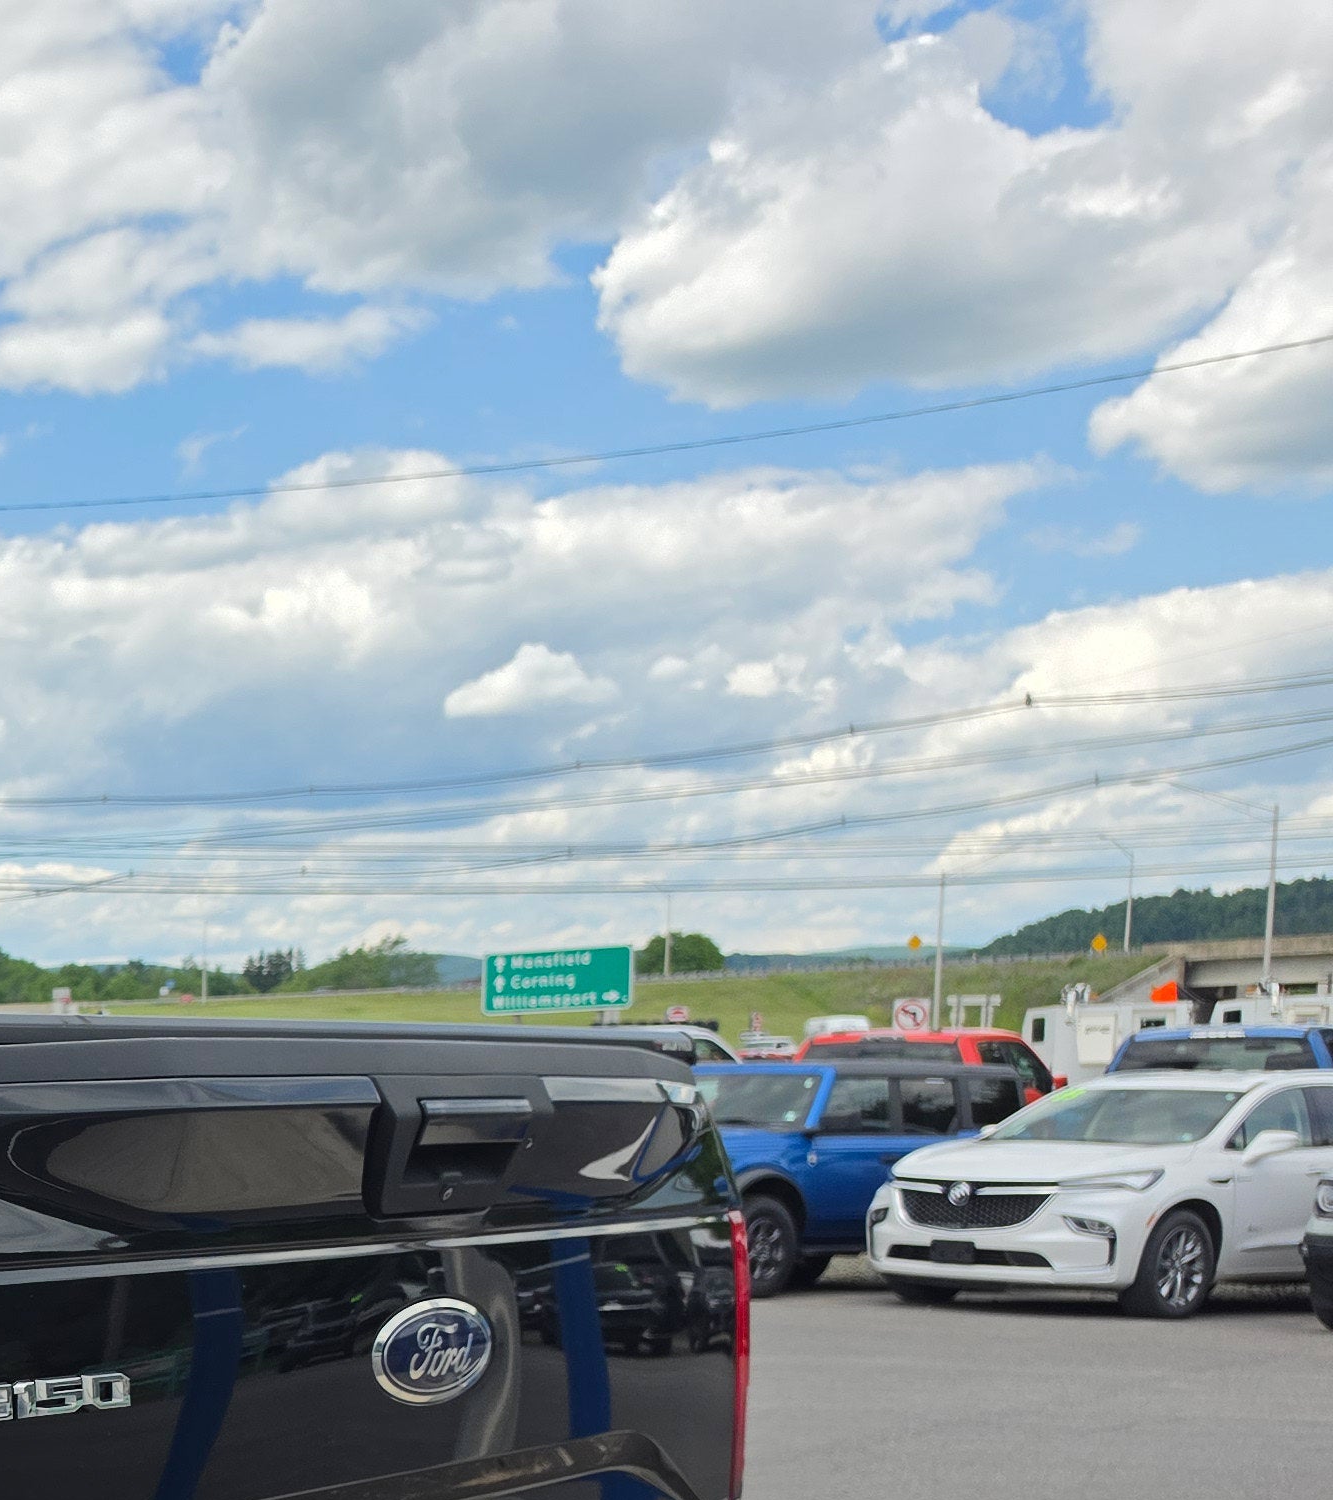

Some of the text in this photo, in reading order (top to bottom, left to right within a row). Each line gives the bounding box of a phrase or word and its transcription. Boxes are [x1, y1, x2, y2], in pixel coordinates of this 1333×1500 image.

[510, 952, 592, 970] Mansfield
[510, 973, 576, 990] Corning
[492, 991, 597, 1009] Williamsport
